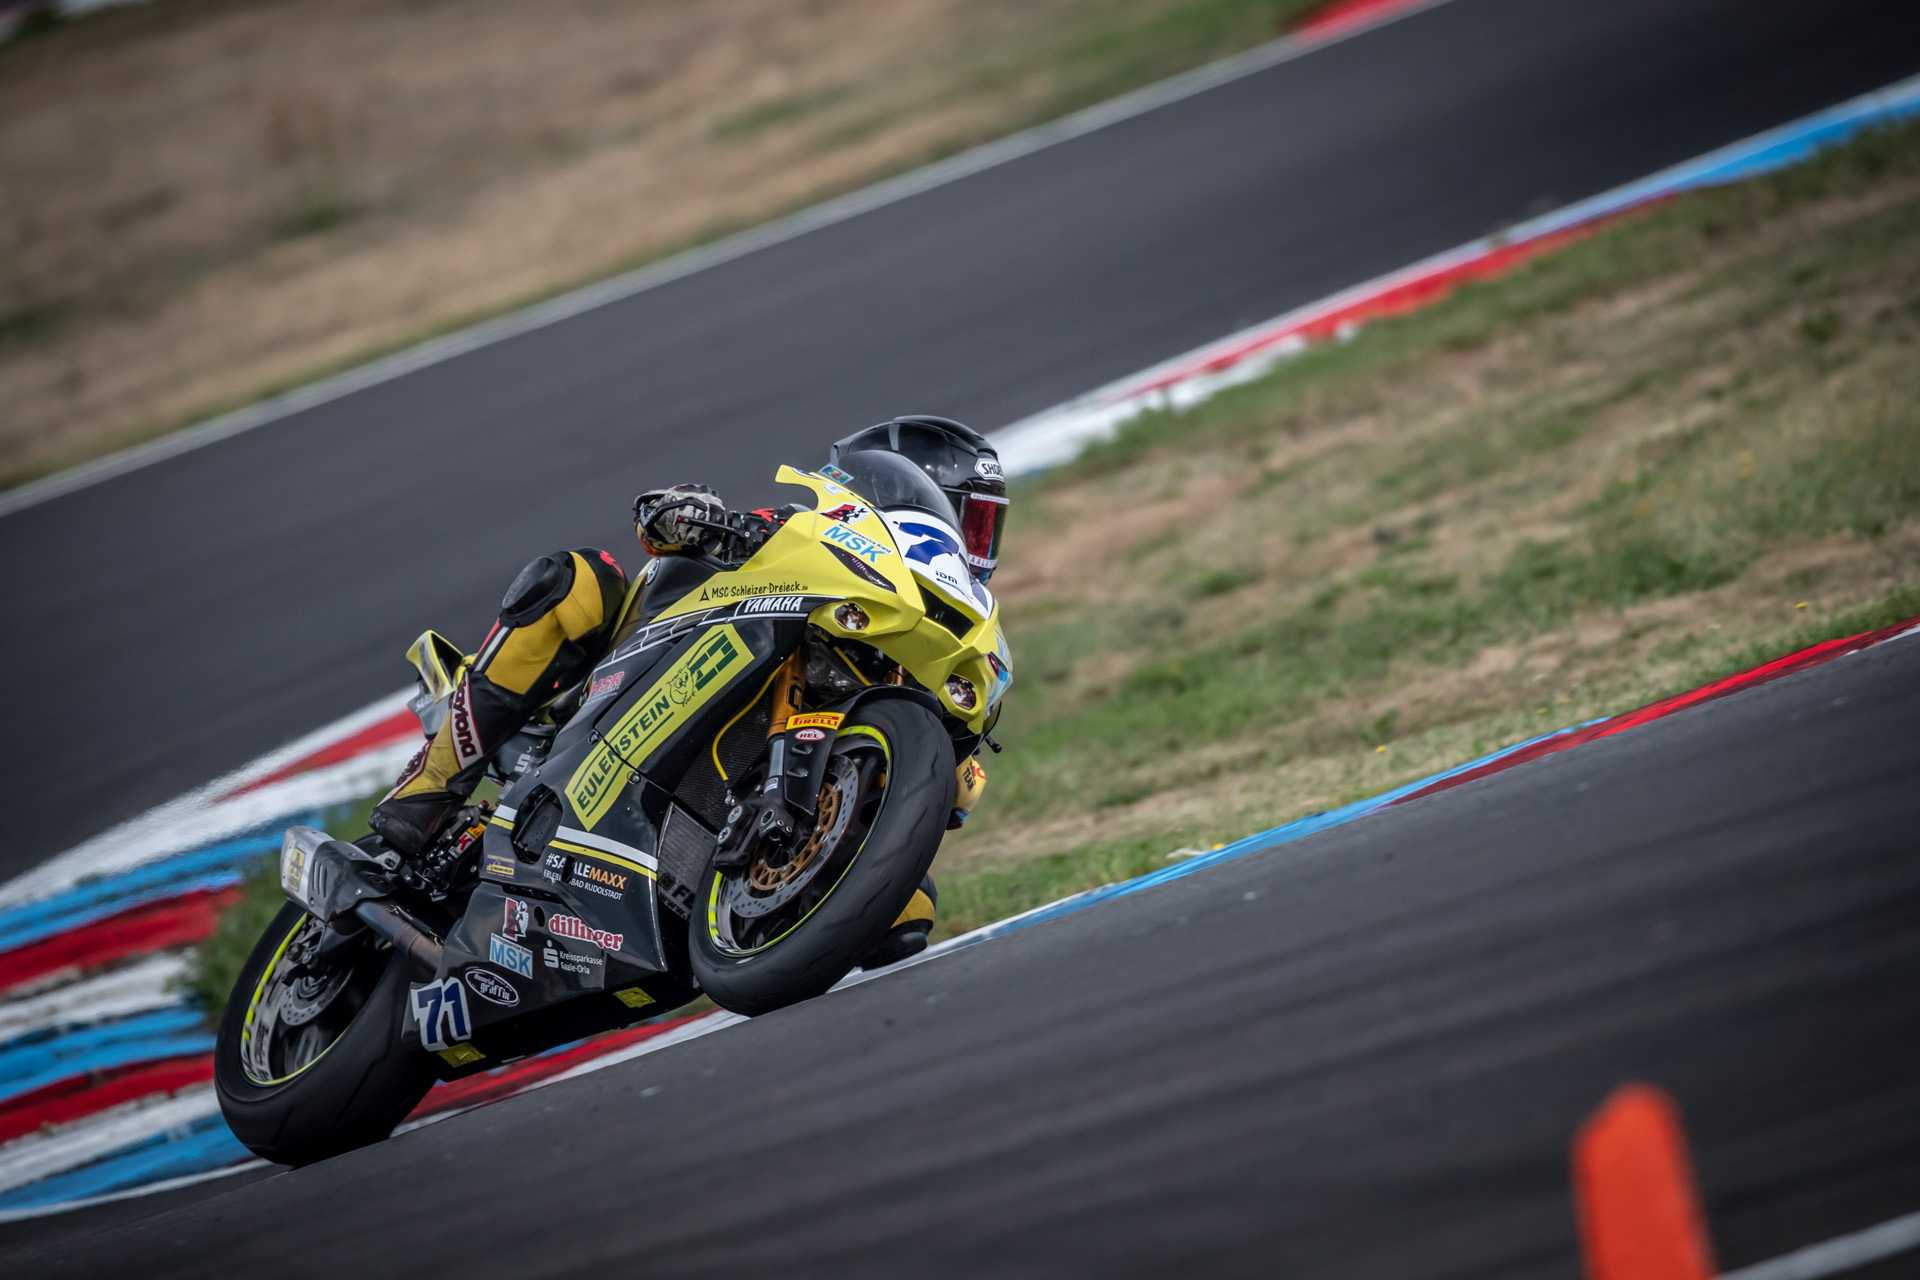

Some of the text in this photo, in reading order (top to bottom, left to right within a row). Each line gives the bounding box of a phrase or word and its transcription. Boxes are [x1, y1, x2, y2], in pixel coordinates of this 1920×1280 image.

[823, 526, 887, 563] MSK
[743, 597, 804, 613] YAMAHA
[589, 671, 625, 697] HSR
[793, 715, 839, 727] PIRELLI
[576, 695, 670, 810] EULENSTEIN
[584, 881, 623, 901] RUDOLSTADT
[549, 914, 623, 950] dillinger
[491, 940, 532, 977] MSK
[559, 950, 603, 966] Kreissparkasse
[560, 961, 591, 975] Saale-Orla
[417, 982, 469, 1045] 71
